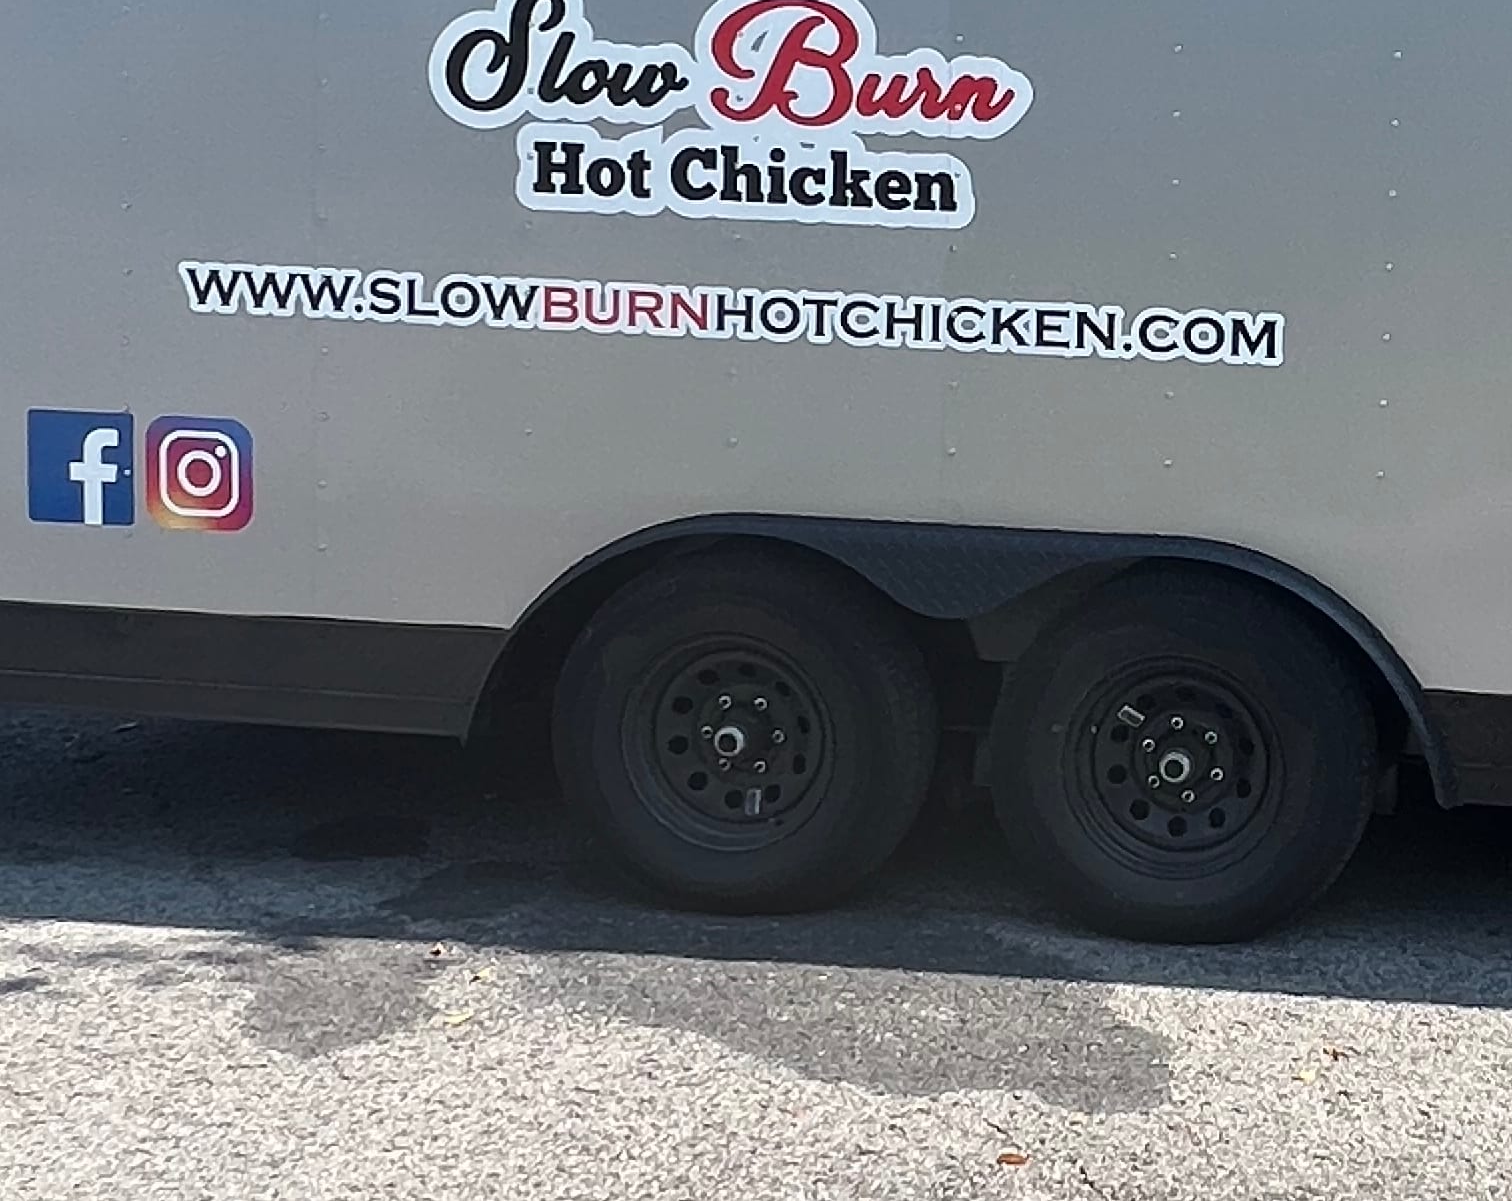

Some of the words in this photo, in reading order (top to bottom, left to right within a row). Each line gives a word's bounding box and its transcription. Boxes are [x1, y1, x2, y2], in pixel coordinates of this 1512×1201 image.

[531, 141, 653, 201] Hot
[669, 141, 960, 212] Chicken
[183, 265, 1282, 362] WWW.SLOWBURNHOTCHICKEN.COM
